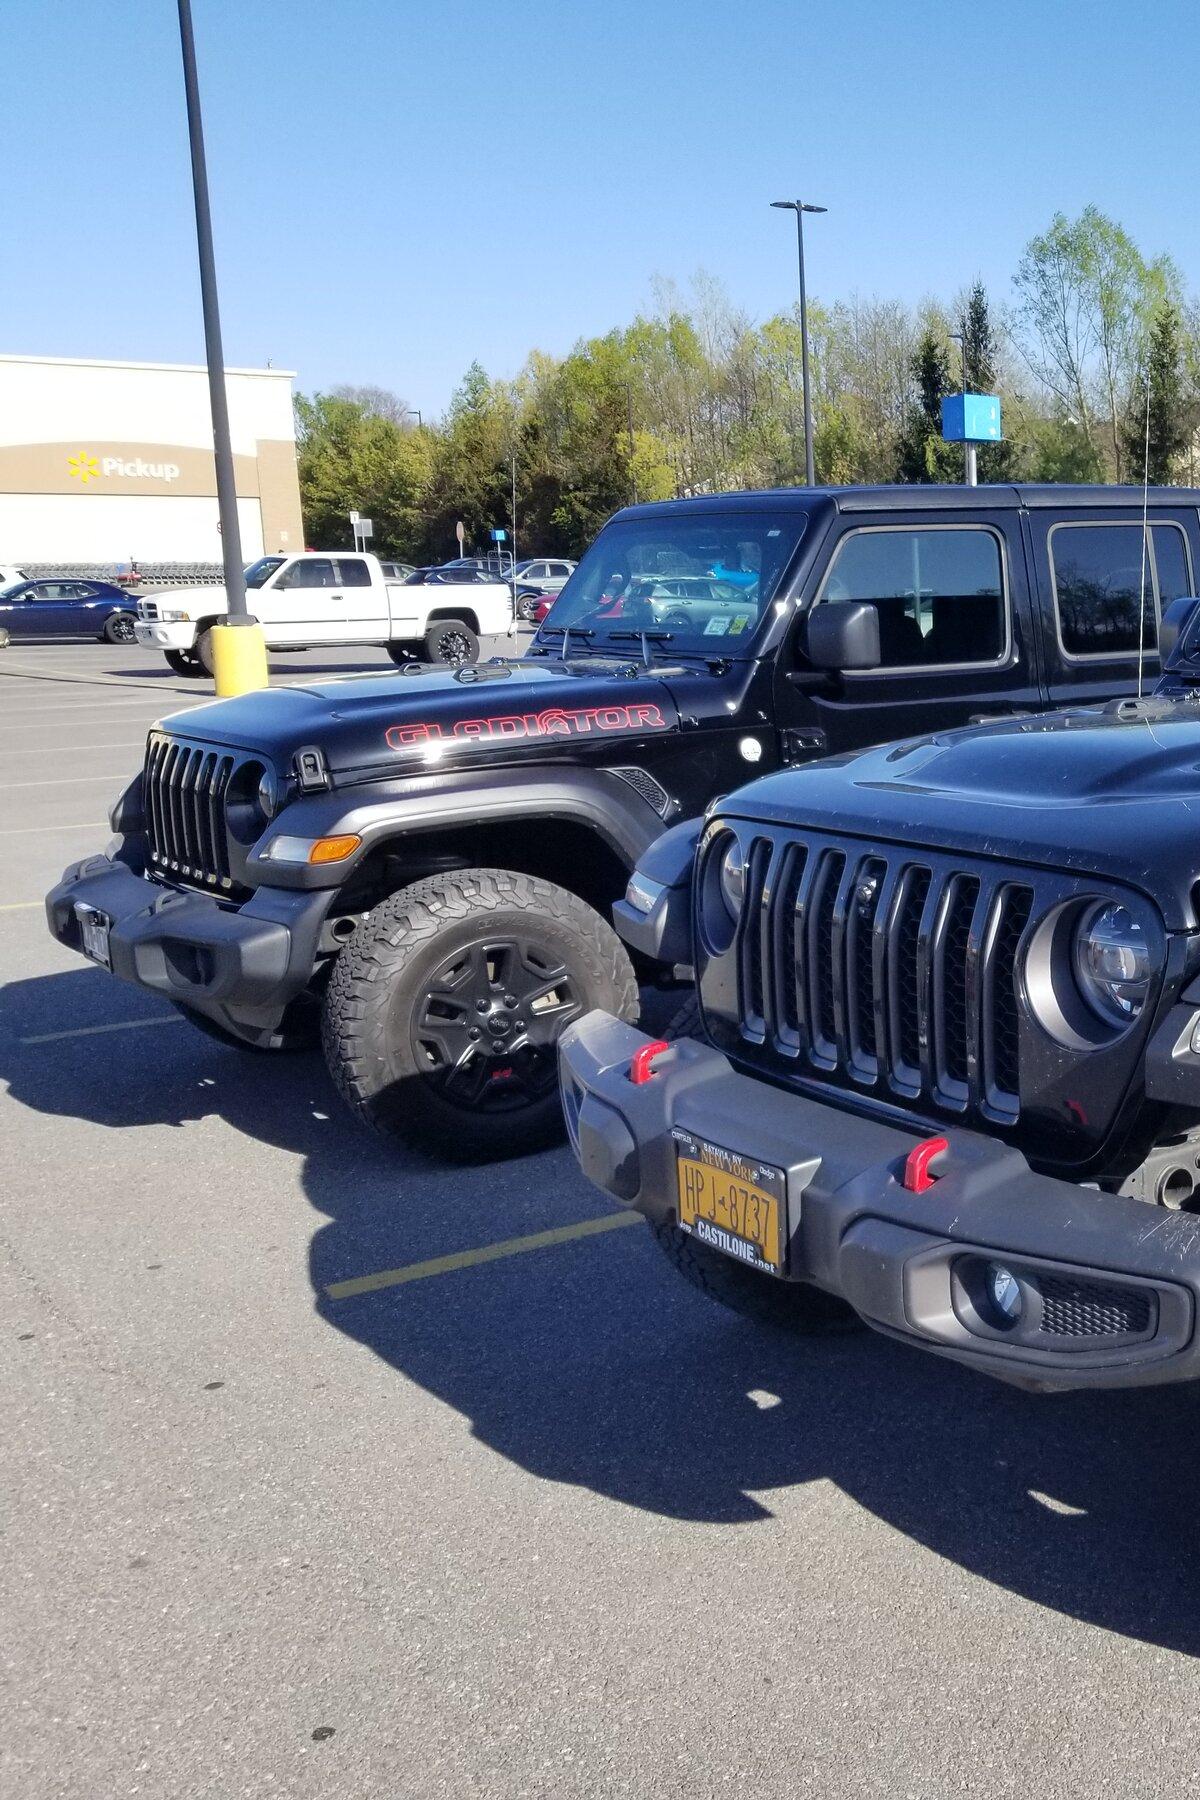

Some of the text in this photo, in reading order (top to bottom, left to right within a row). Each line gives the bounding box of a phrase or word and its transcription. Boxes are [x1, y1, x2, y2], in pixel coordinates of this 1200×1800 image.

[102, 457, 180, 482] Pickup
[384, 703, 665, 751] GLADIATOR
[701, 1148, 756, 1185] NEW YORK
